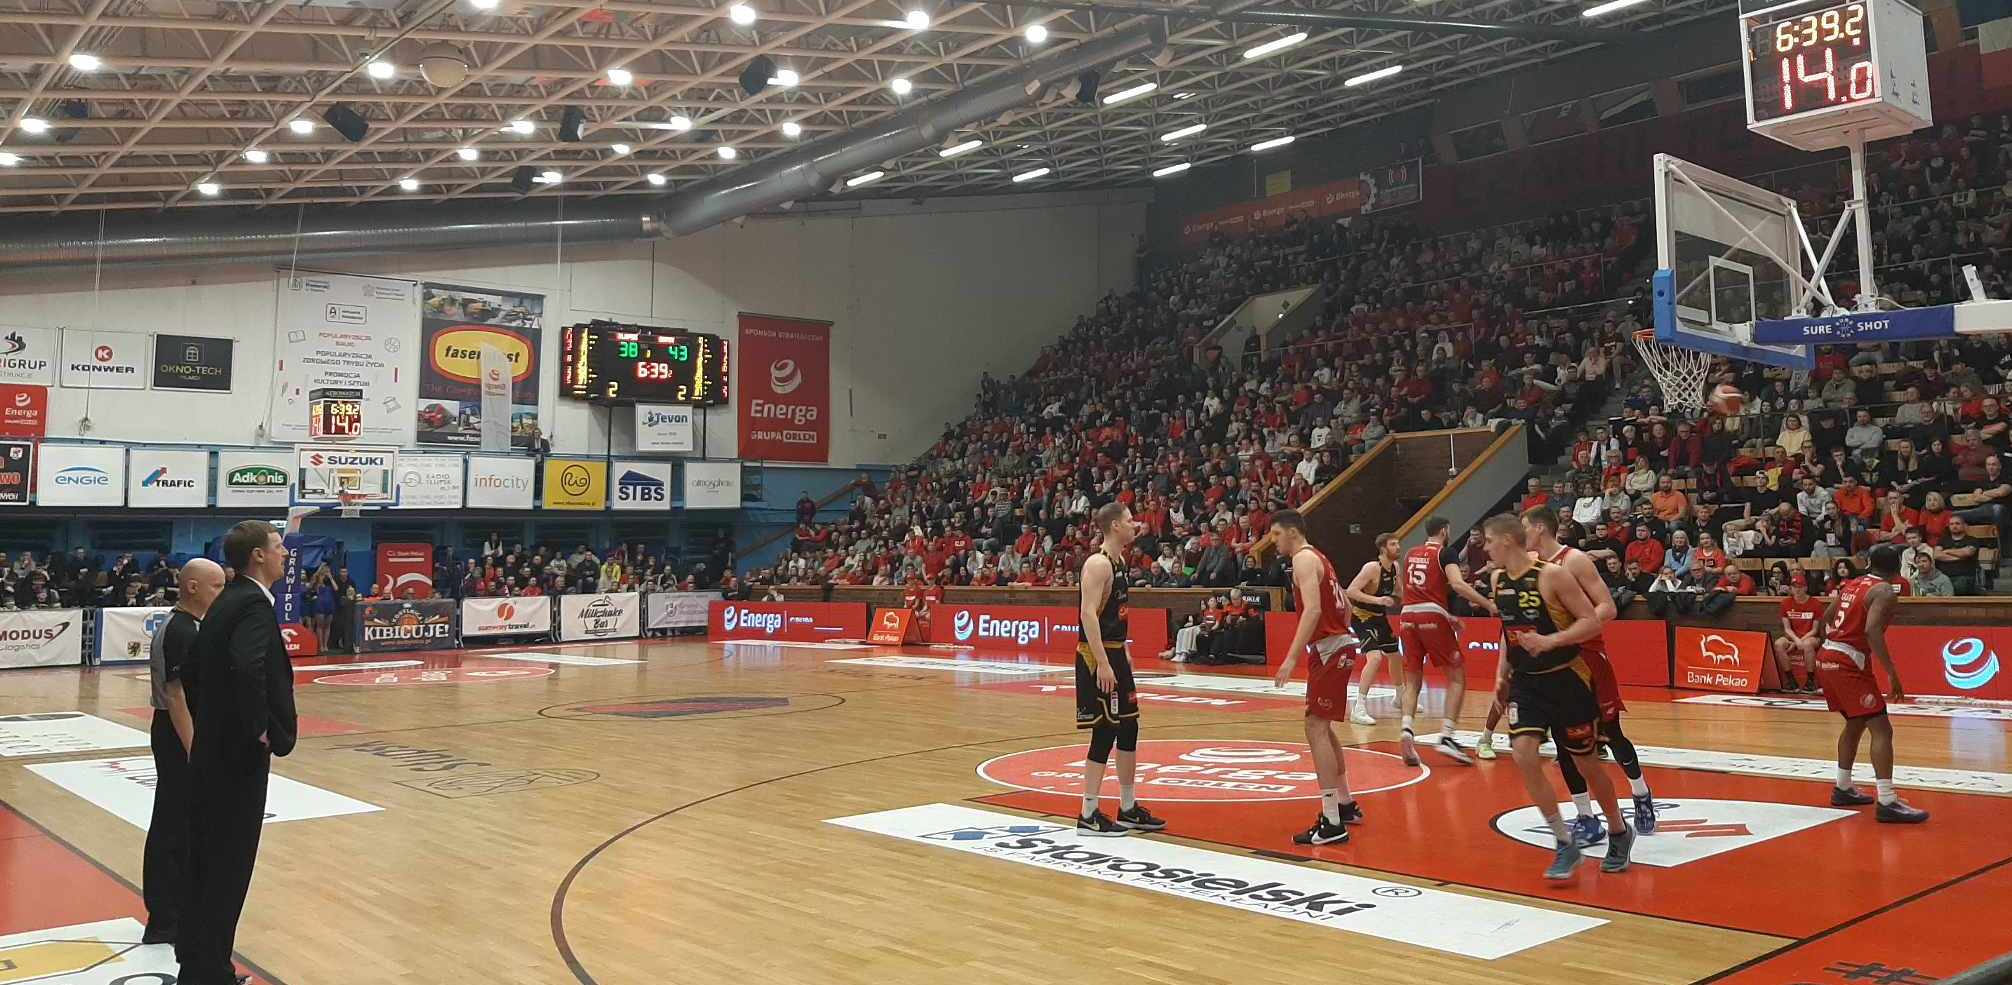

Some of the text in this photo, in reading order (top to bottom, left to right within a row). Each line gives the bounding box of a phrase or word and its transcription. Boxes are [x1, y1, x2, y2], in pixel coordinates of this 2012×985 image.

[1776, 4, 1864, 52] 6:39.2
[1781, 47, 1873, 110] 14.0
[1802, 319, 1891, 336] SURE SHOT
[619, 341, 688, 361] 38 43
[71, 364, 135, 374] KONWER
[160, 364, 223, 376] OKNO-TECH
[5, 407, 39, 418] Energa
[750, 399, 817, 425] Energa
[751, 430, 815, 442] GRUPA ORLEN
[327, 455, 384, 467] SUZUKI
[156, 479, 194, 488] TRAFIC
[474, 474, 529, 492] infocity
[618, 484, 665, 501] STBS
[1407, 565, 1427, 585] 15
[284, 547, 297, 621] GRAWIPOL
[1518, 591, 1540, 608] 25
[740, 609, 782, 633] Energa
[978, 614, 1040, 645] Energa
[364, 624, 450, 640] KIBICUJE!
[1687, 671, 1748, 688] Bank Pekao
[1158, 779, 1282, 791] ORLEN
[1007, 852, 1126, 879] FABRYKA
[995, 837, 1376, 917] Starosielski
